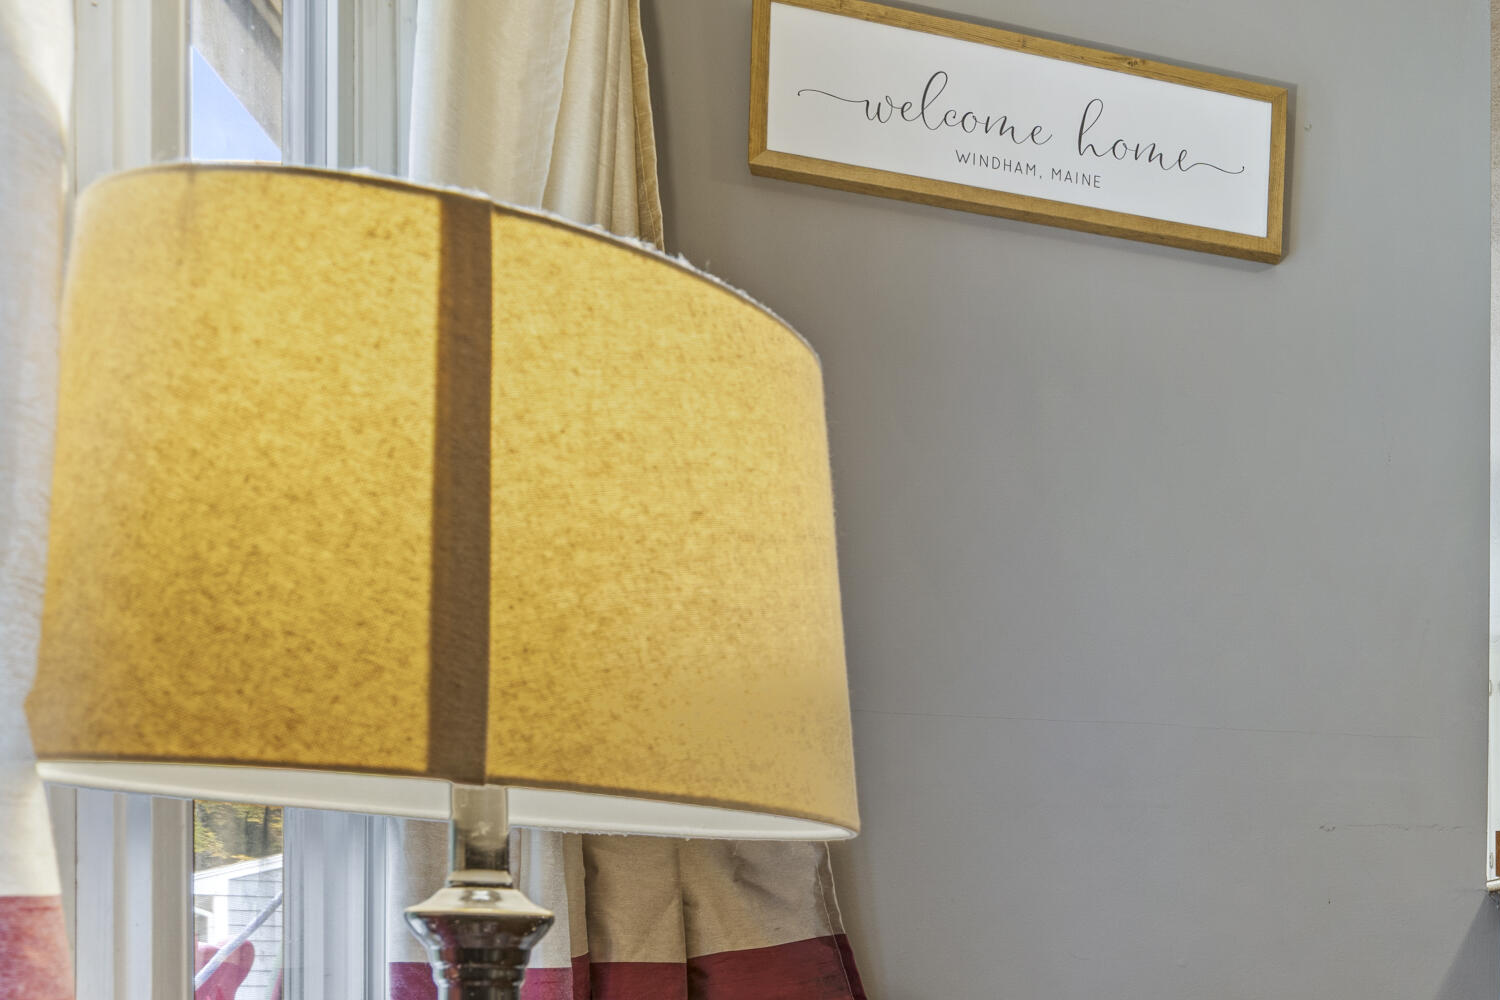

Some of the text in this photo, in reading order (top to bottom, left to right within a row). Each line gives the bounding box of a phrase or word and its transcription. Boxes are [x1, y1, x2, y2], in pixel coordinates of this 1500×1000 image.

[797, 70, 1245, 175] welcome home
[955, 149, 1102, 189] WINDHAM, MAINE
